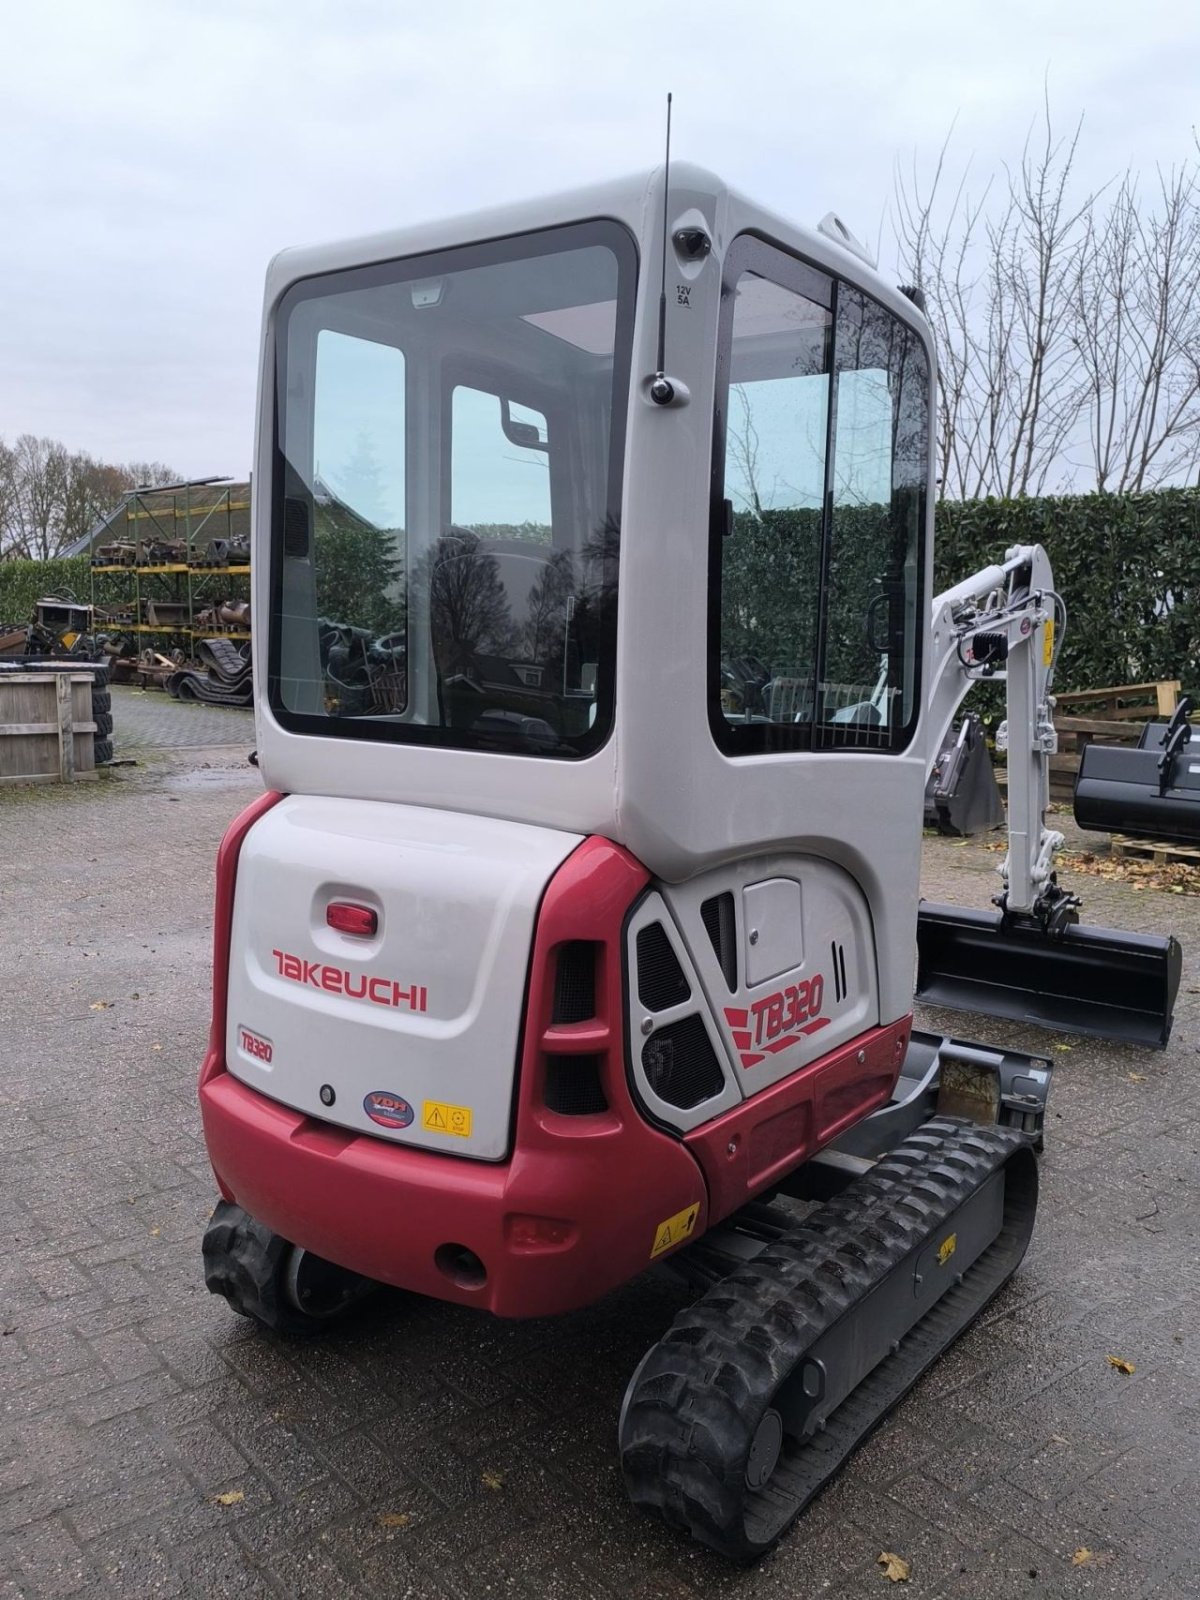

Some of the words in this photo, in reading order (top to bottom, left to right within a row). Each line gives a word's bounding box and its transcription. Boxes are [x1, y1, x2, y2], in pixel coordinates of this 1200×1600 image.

[676, 285, 692, 296] 12V
[677, 294, 690, 306] 5A
[750, 973, 824, 1047] TB320
[241, 1031, 273, 1063] TB320
[370, 1095, 408, 1113] VDH
